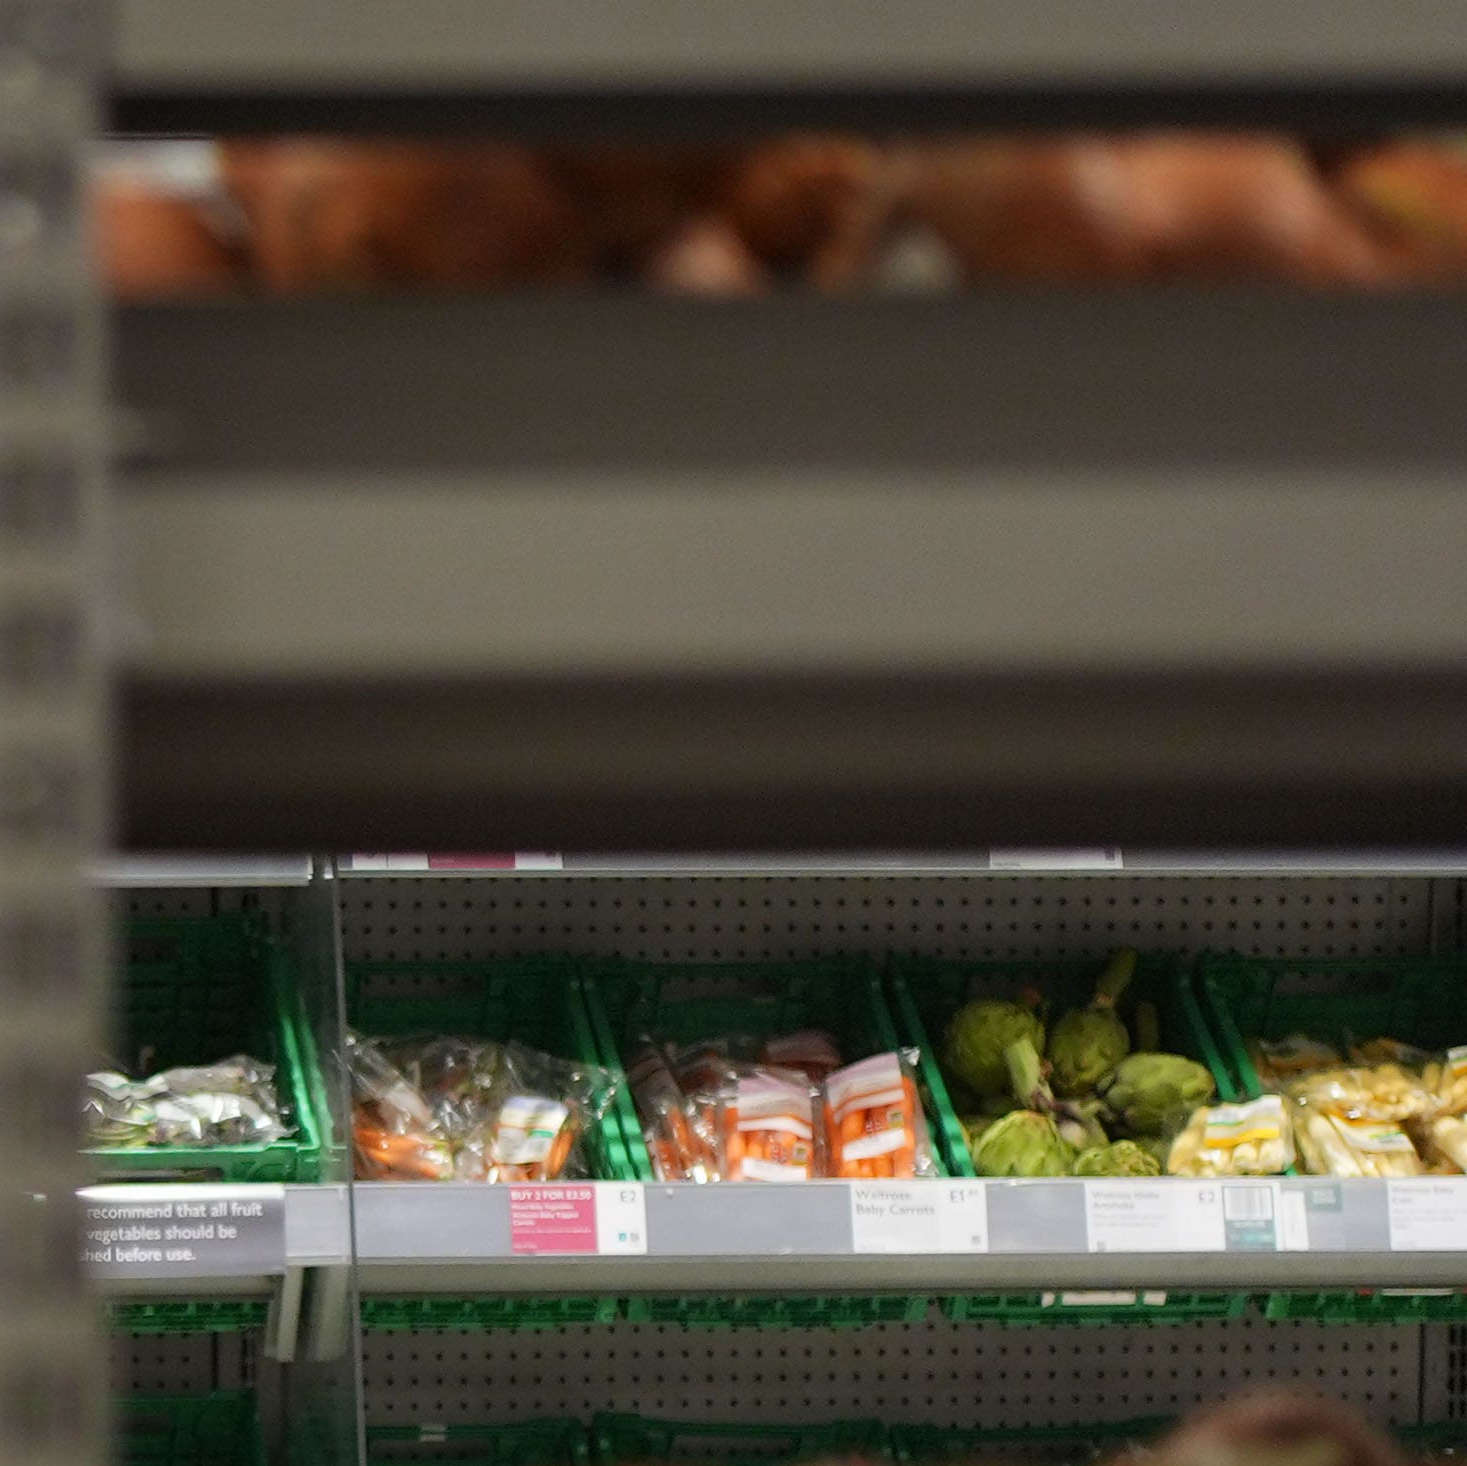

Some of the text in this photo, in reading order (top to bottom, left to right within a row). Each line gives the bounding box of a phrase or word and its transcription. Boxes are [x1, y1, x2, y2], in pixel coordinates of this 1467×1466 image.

[511, 1190, 533, 1201] BUY
[543, 1190, 564, 1201] FOR
[855, 1190, 912, 1201] Waitrose
[86, 1202, 264, 1219] recommend that all fruit
[856, 1204, 936, 1216] Baby Carrots
[86, 1224, 238, 1245] vegetables should be
[116, 1248, 162, 1262] before
[167, 1249, 196, 1262] use.
